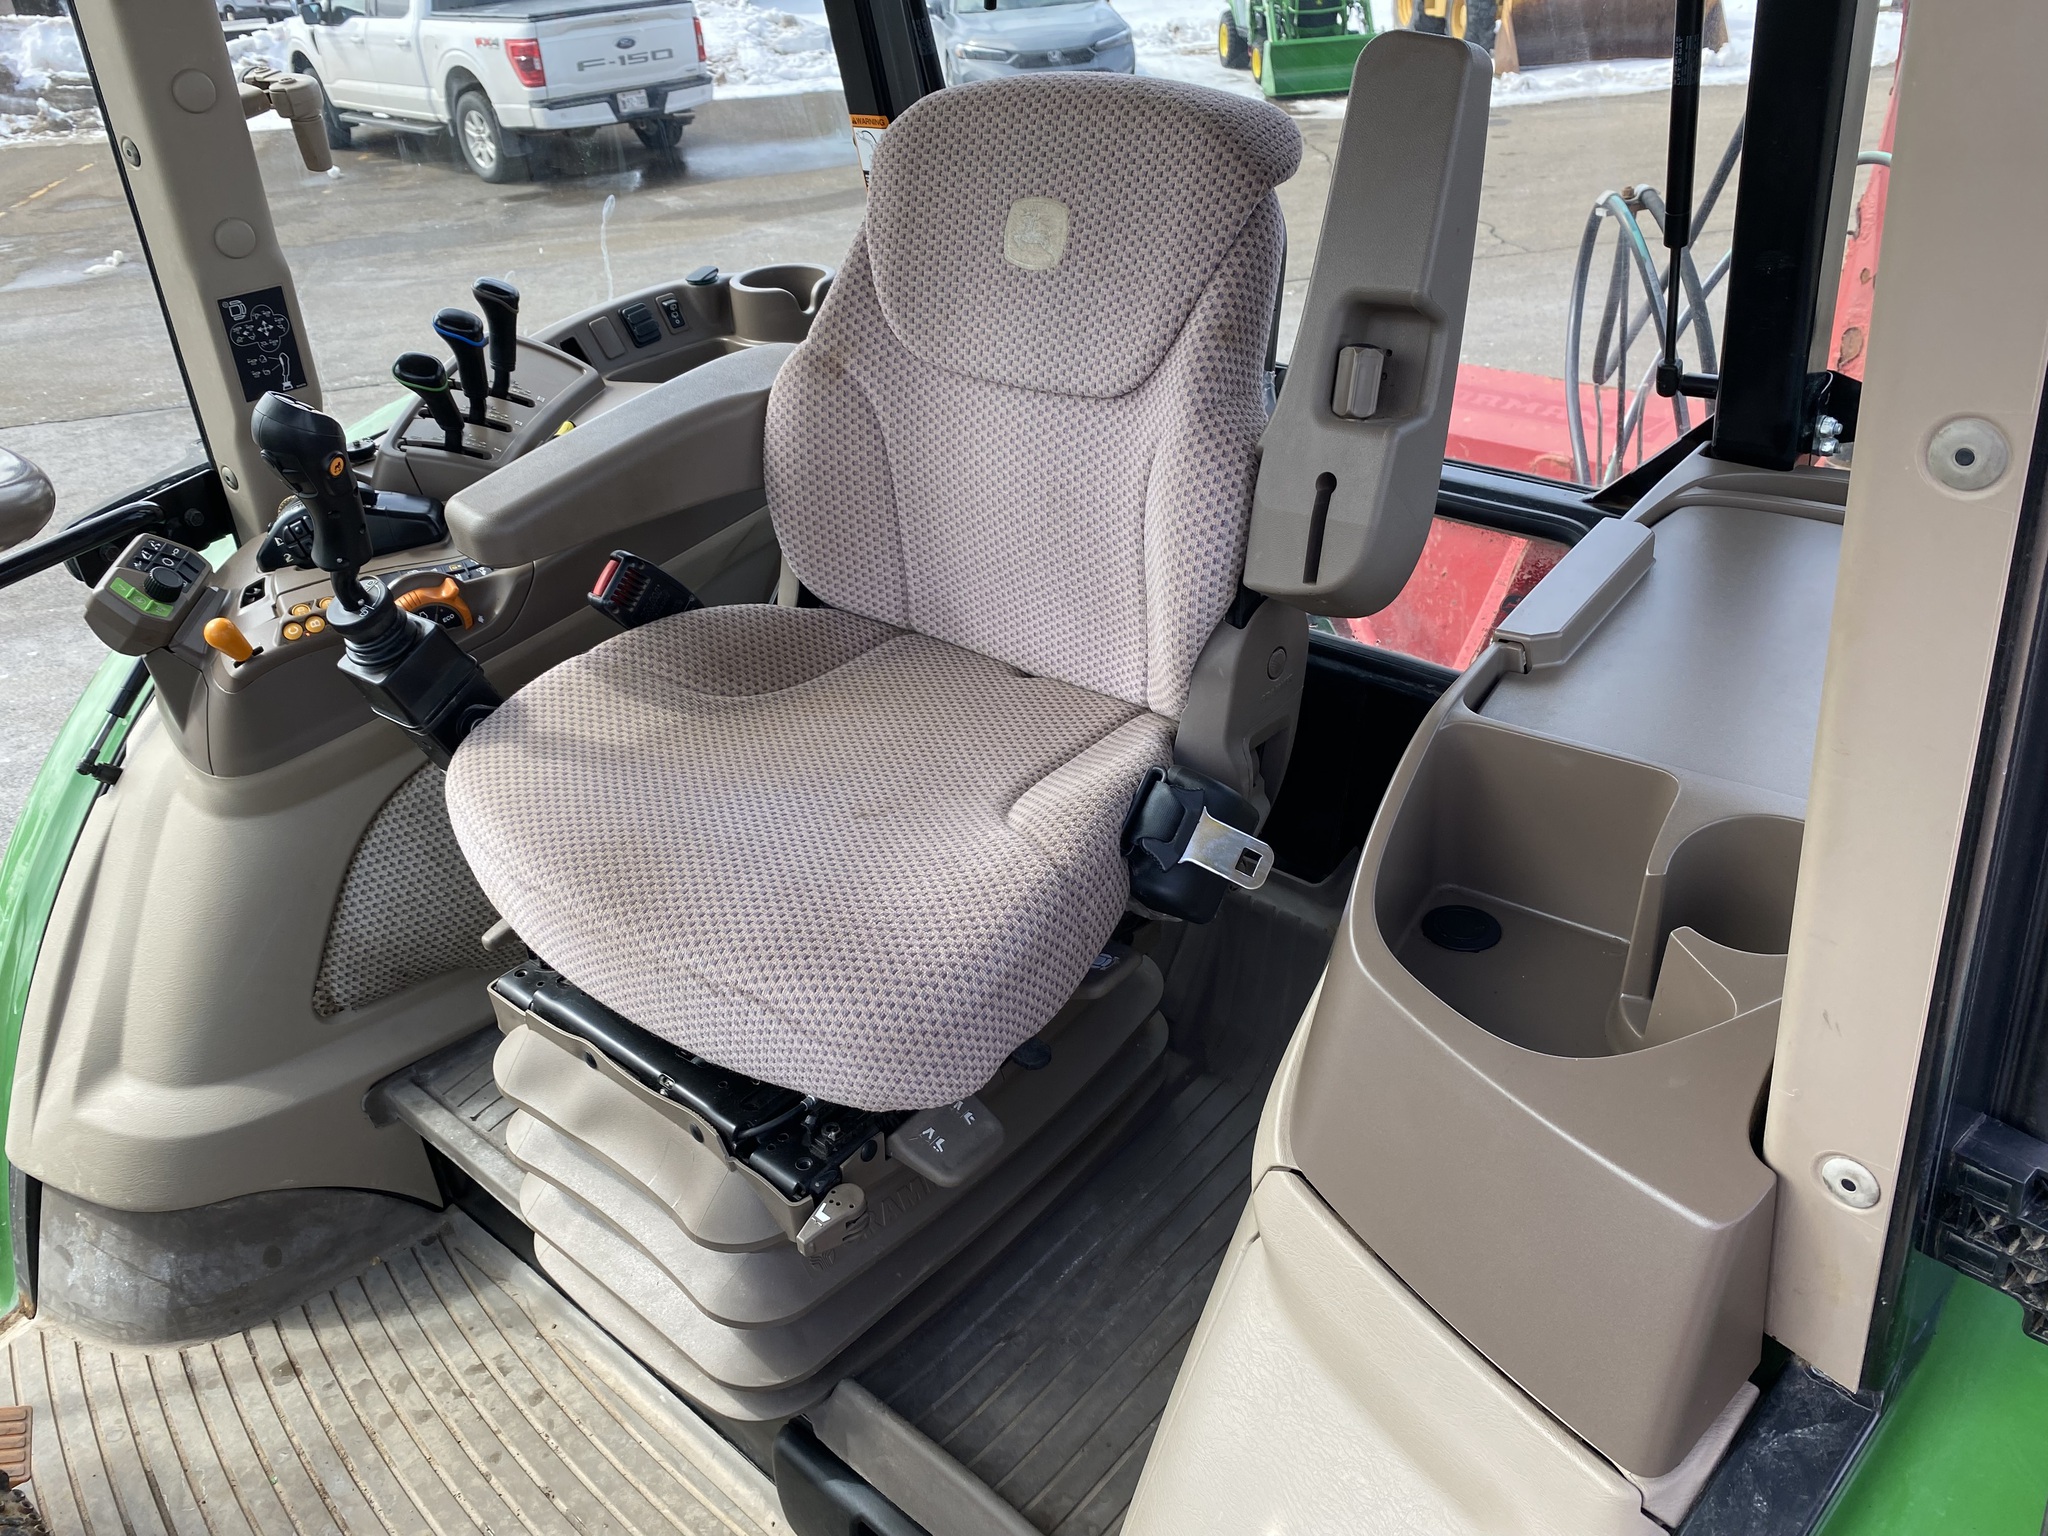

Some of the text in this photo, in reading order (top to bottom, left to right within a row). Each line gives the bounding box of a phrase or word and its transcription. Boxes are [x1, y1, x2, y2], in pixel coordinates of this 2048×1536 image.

[577, 48, 674, 72] F-150
[856, 118, 885, 126] WARNING
[442, 613, 455, 623] ECO
